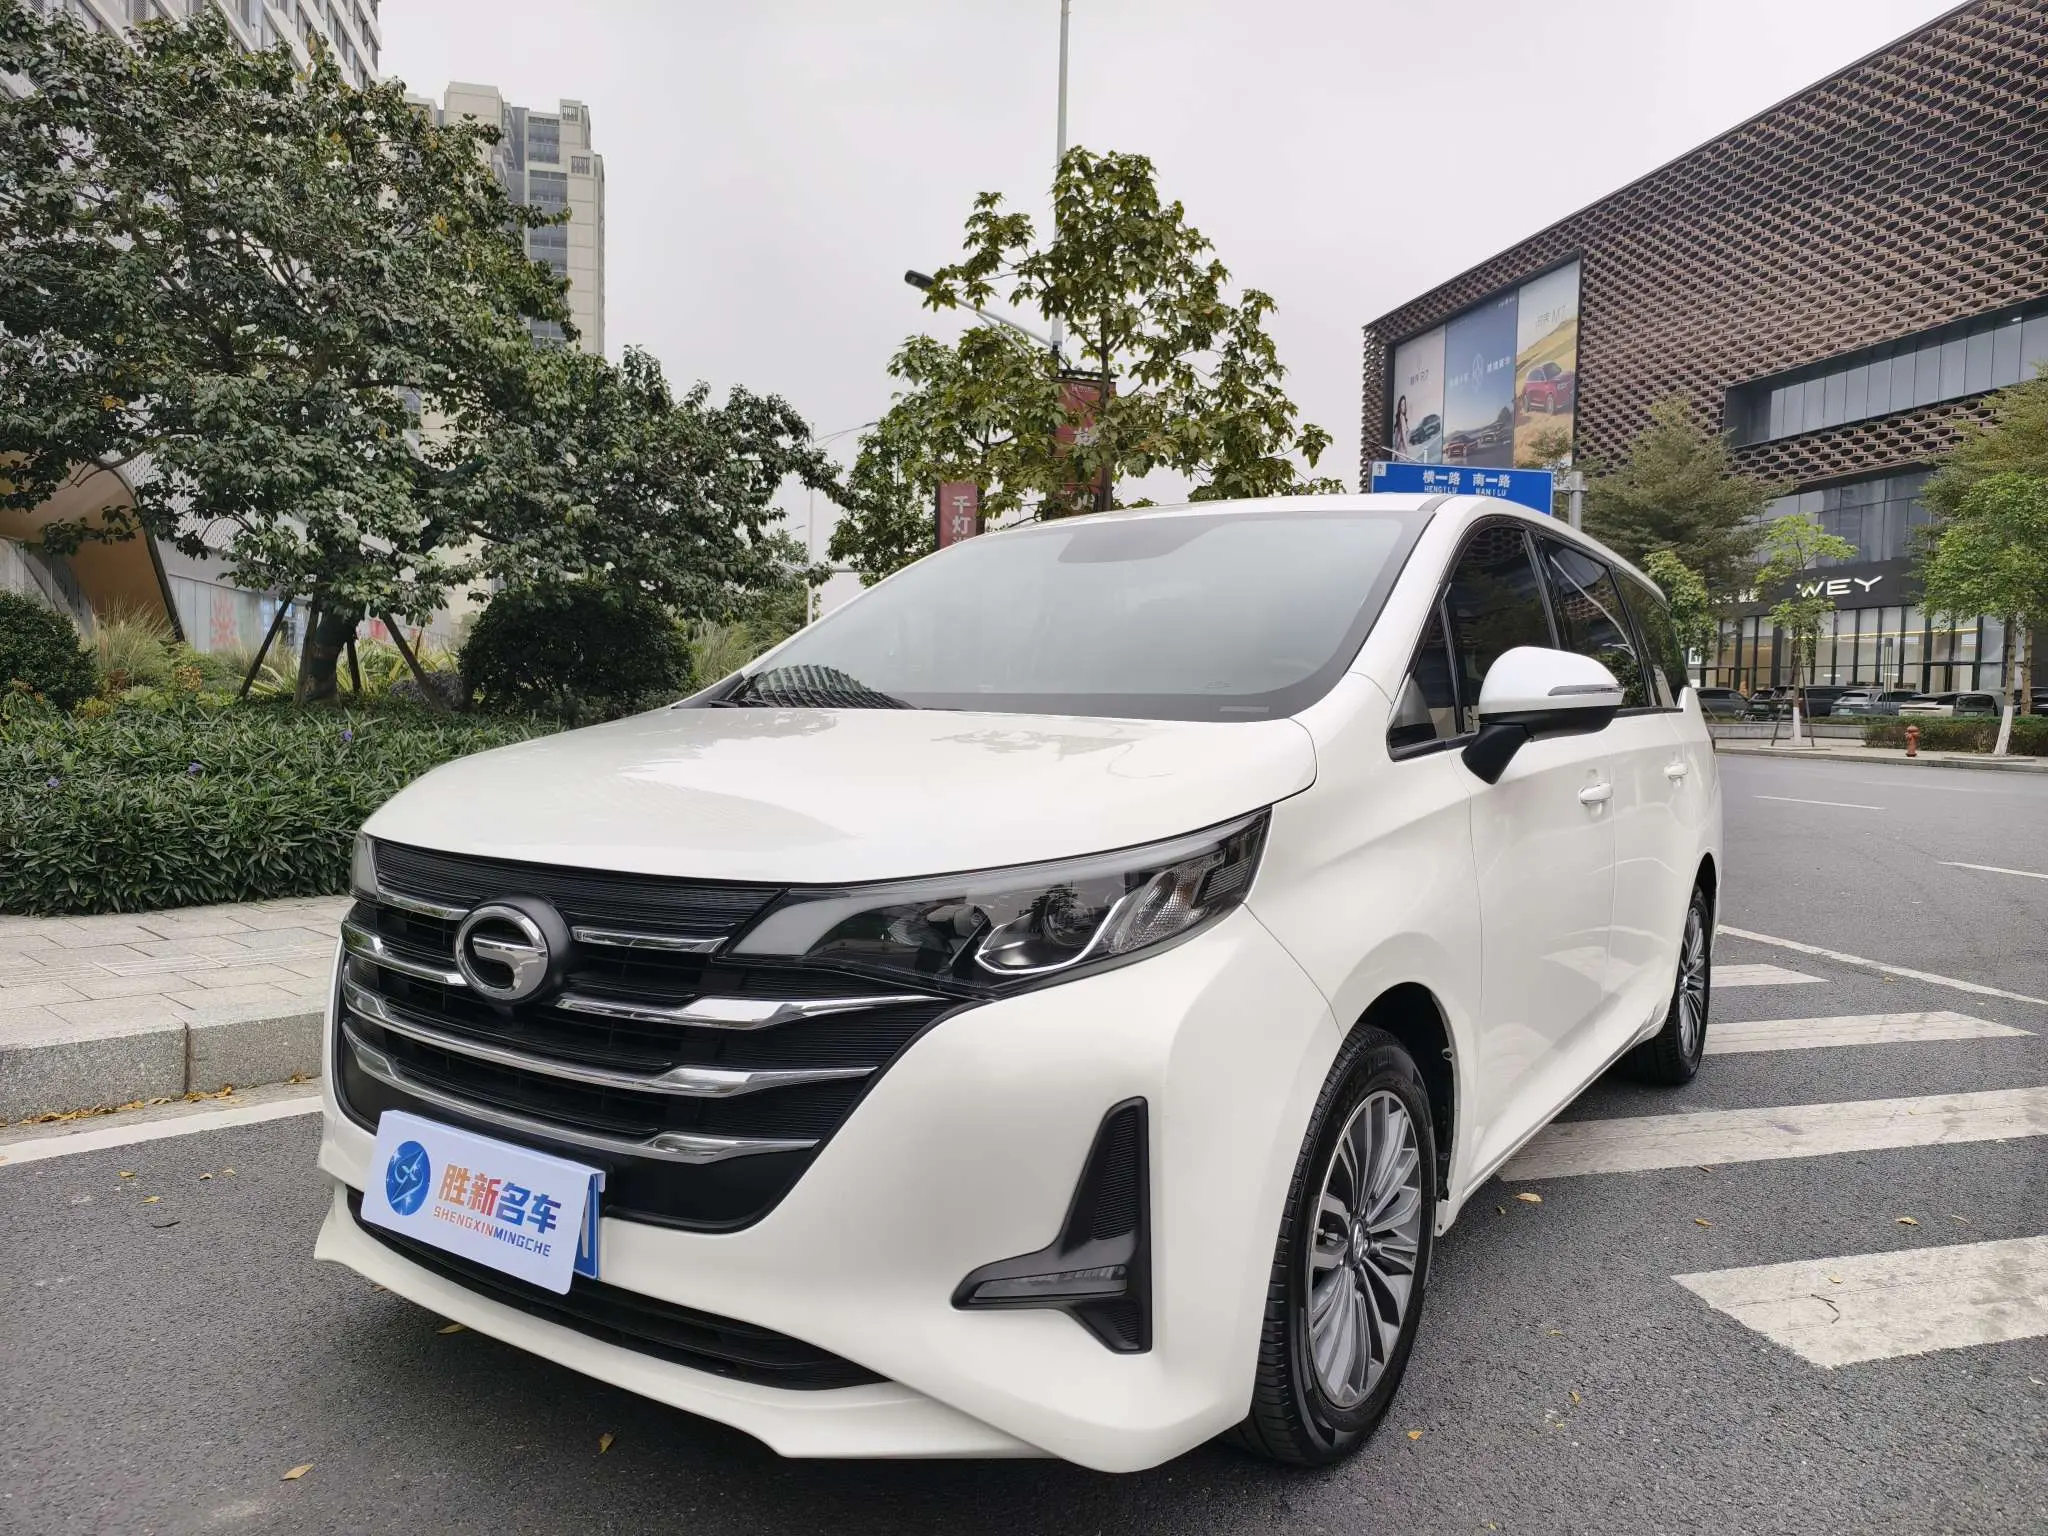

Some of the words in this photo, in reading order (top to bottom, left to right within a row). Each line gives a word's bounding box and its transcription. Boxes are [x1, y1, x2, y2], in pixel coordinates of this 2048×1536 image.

[1472, 472, 1511, 488] 南一路
[1796, 575, 1883, 598] WEY
[439, 1164, 561, 1234] 胜新名车
[434, 1206, 551, 1257] SHENGXINMINGCHE
